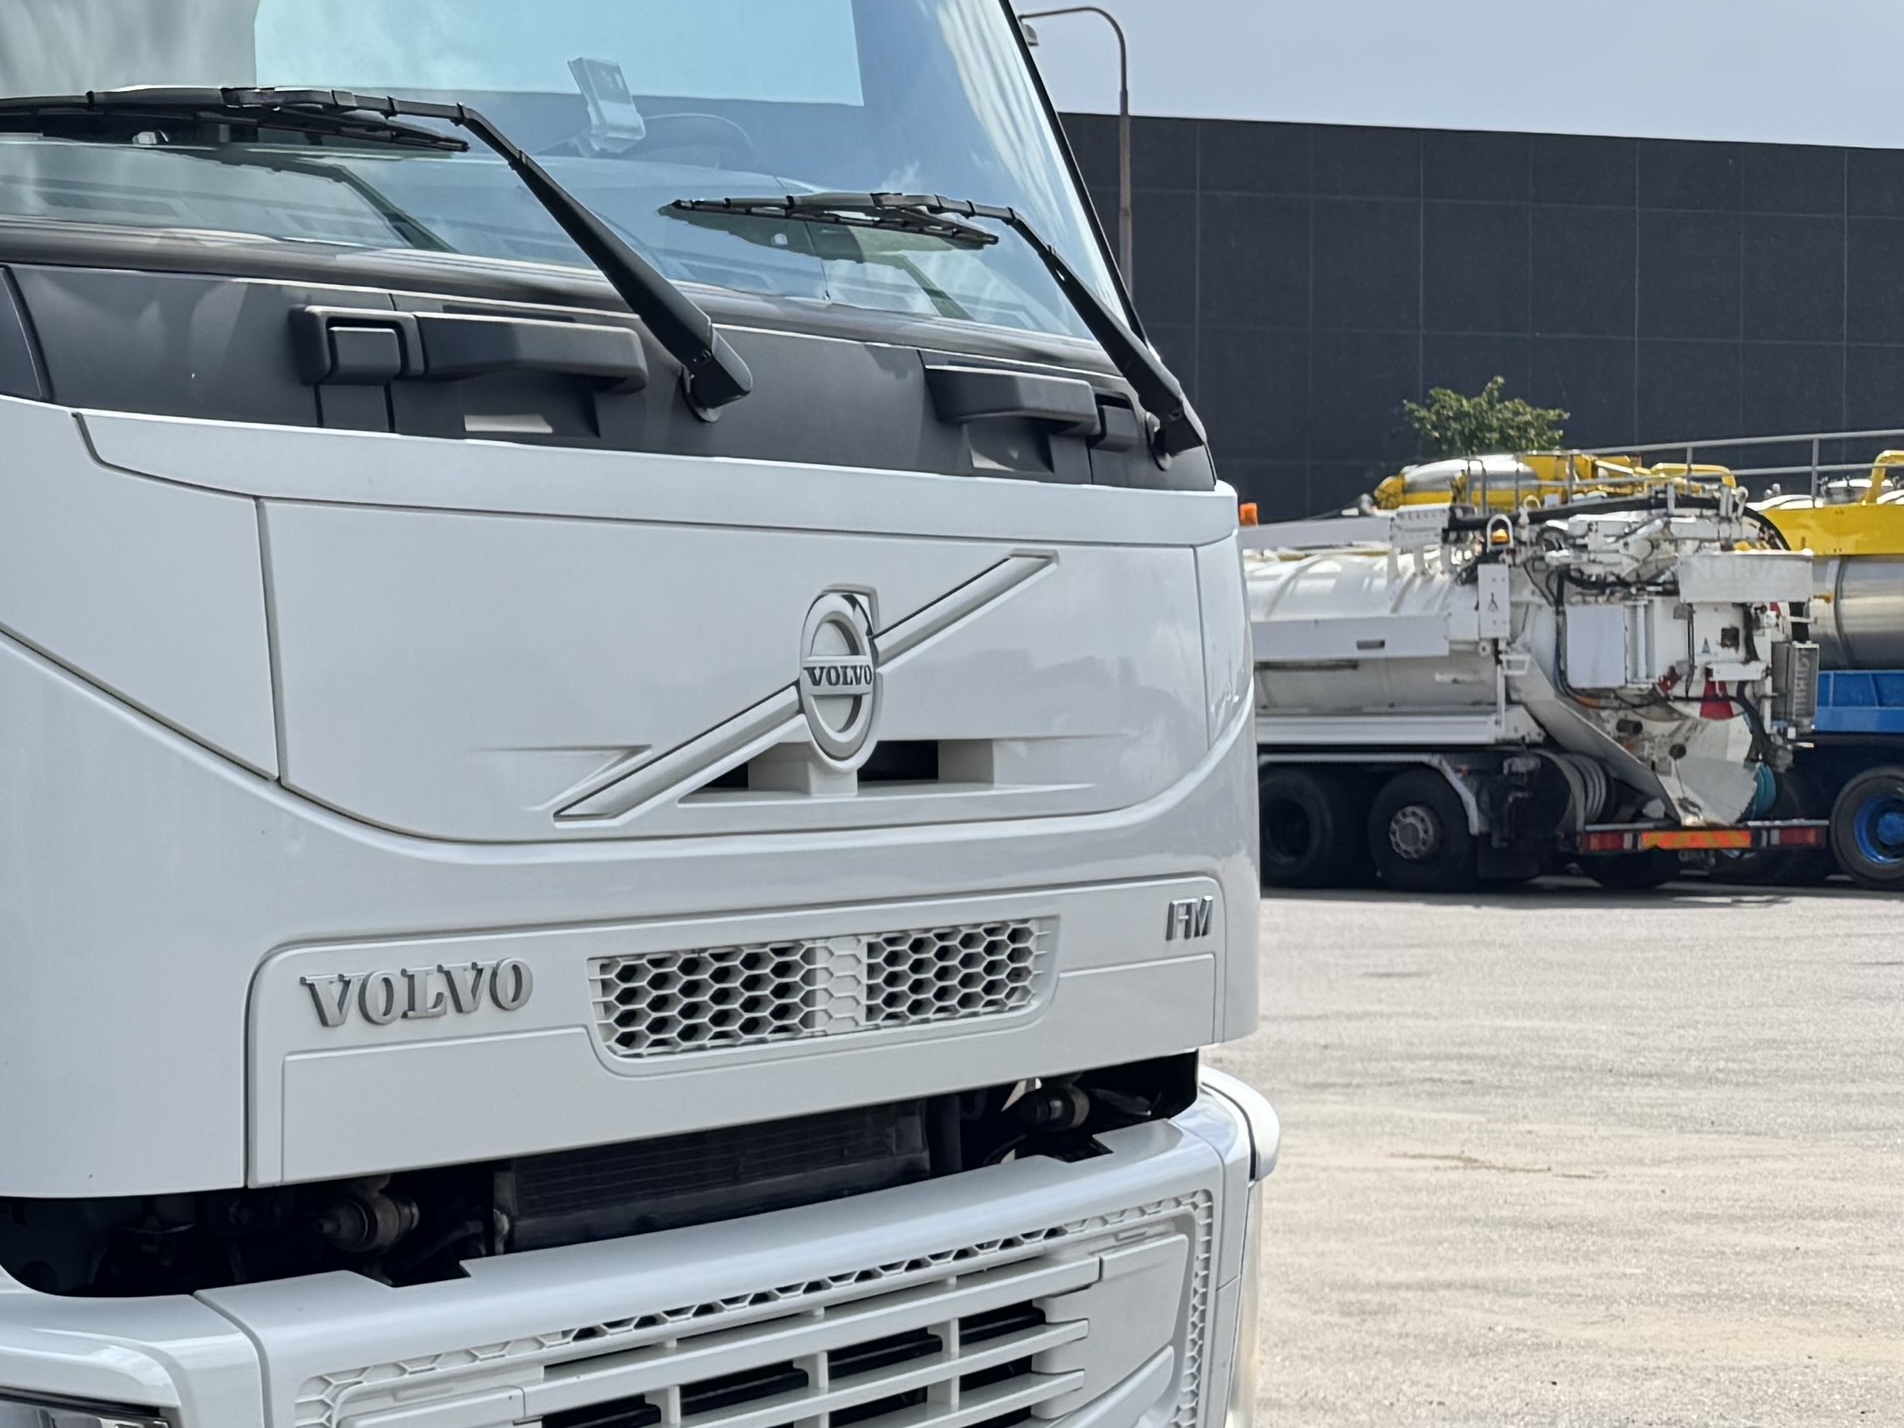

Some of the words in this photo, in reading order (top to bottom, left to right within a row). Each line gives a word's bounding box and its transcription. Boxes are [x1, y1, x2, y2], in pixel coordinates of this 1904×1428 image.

[802, 664, 873, 687] VOLVO
[1165, 895, 1214, 942] FM
[299, 956, 534, 1028] VOLVO
